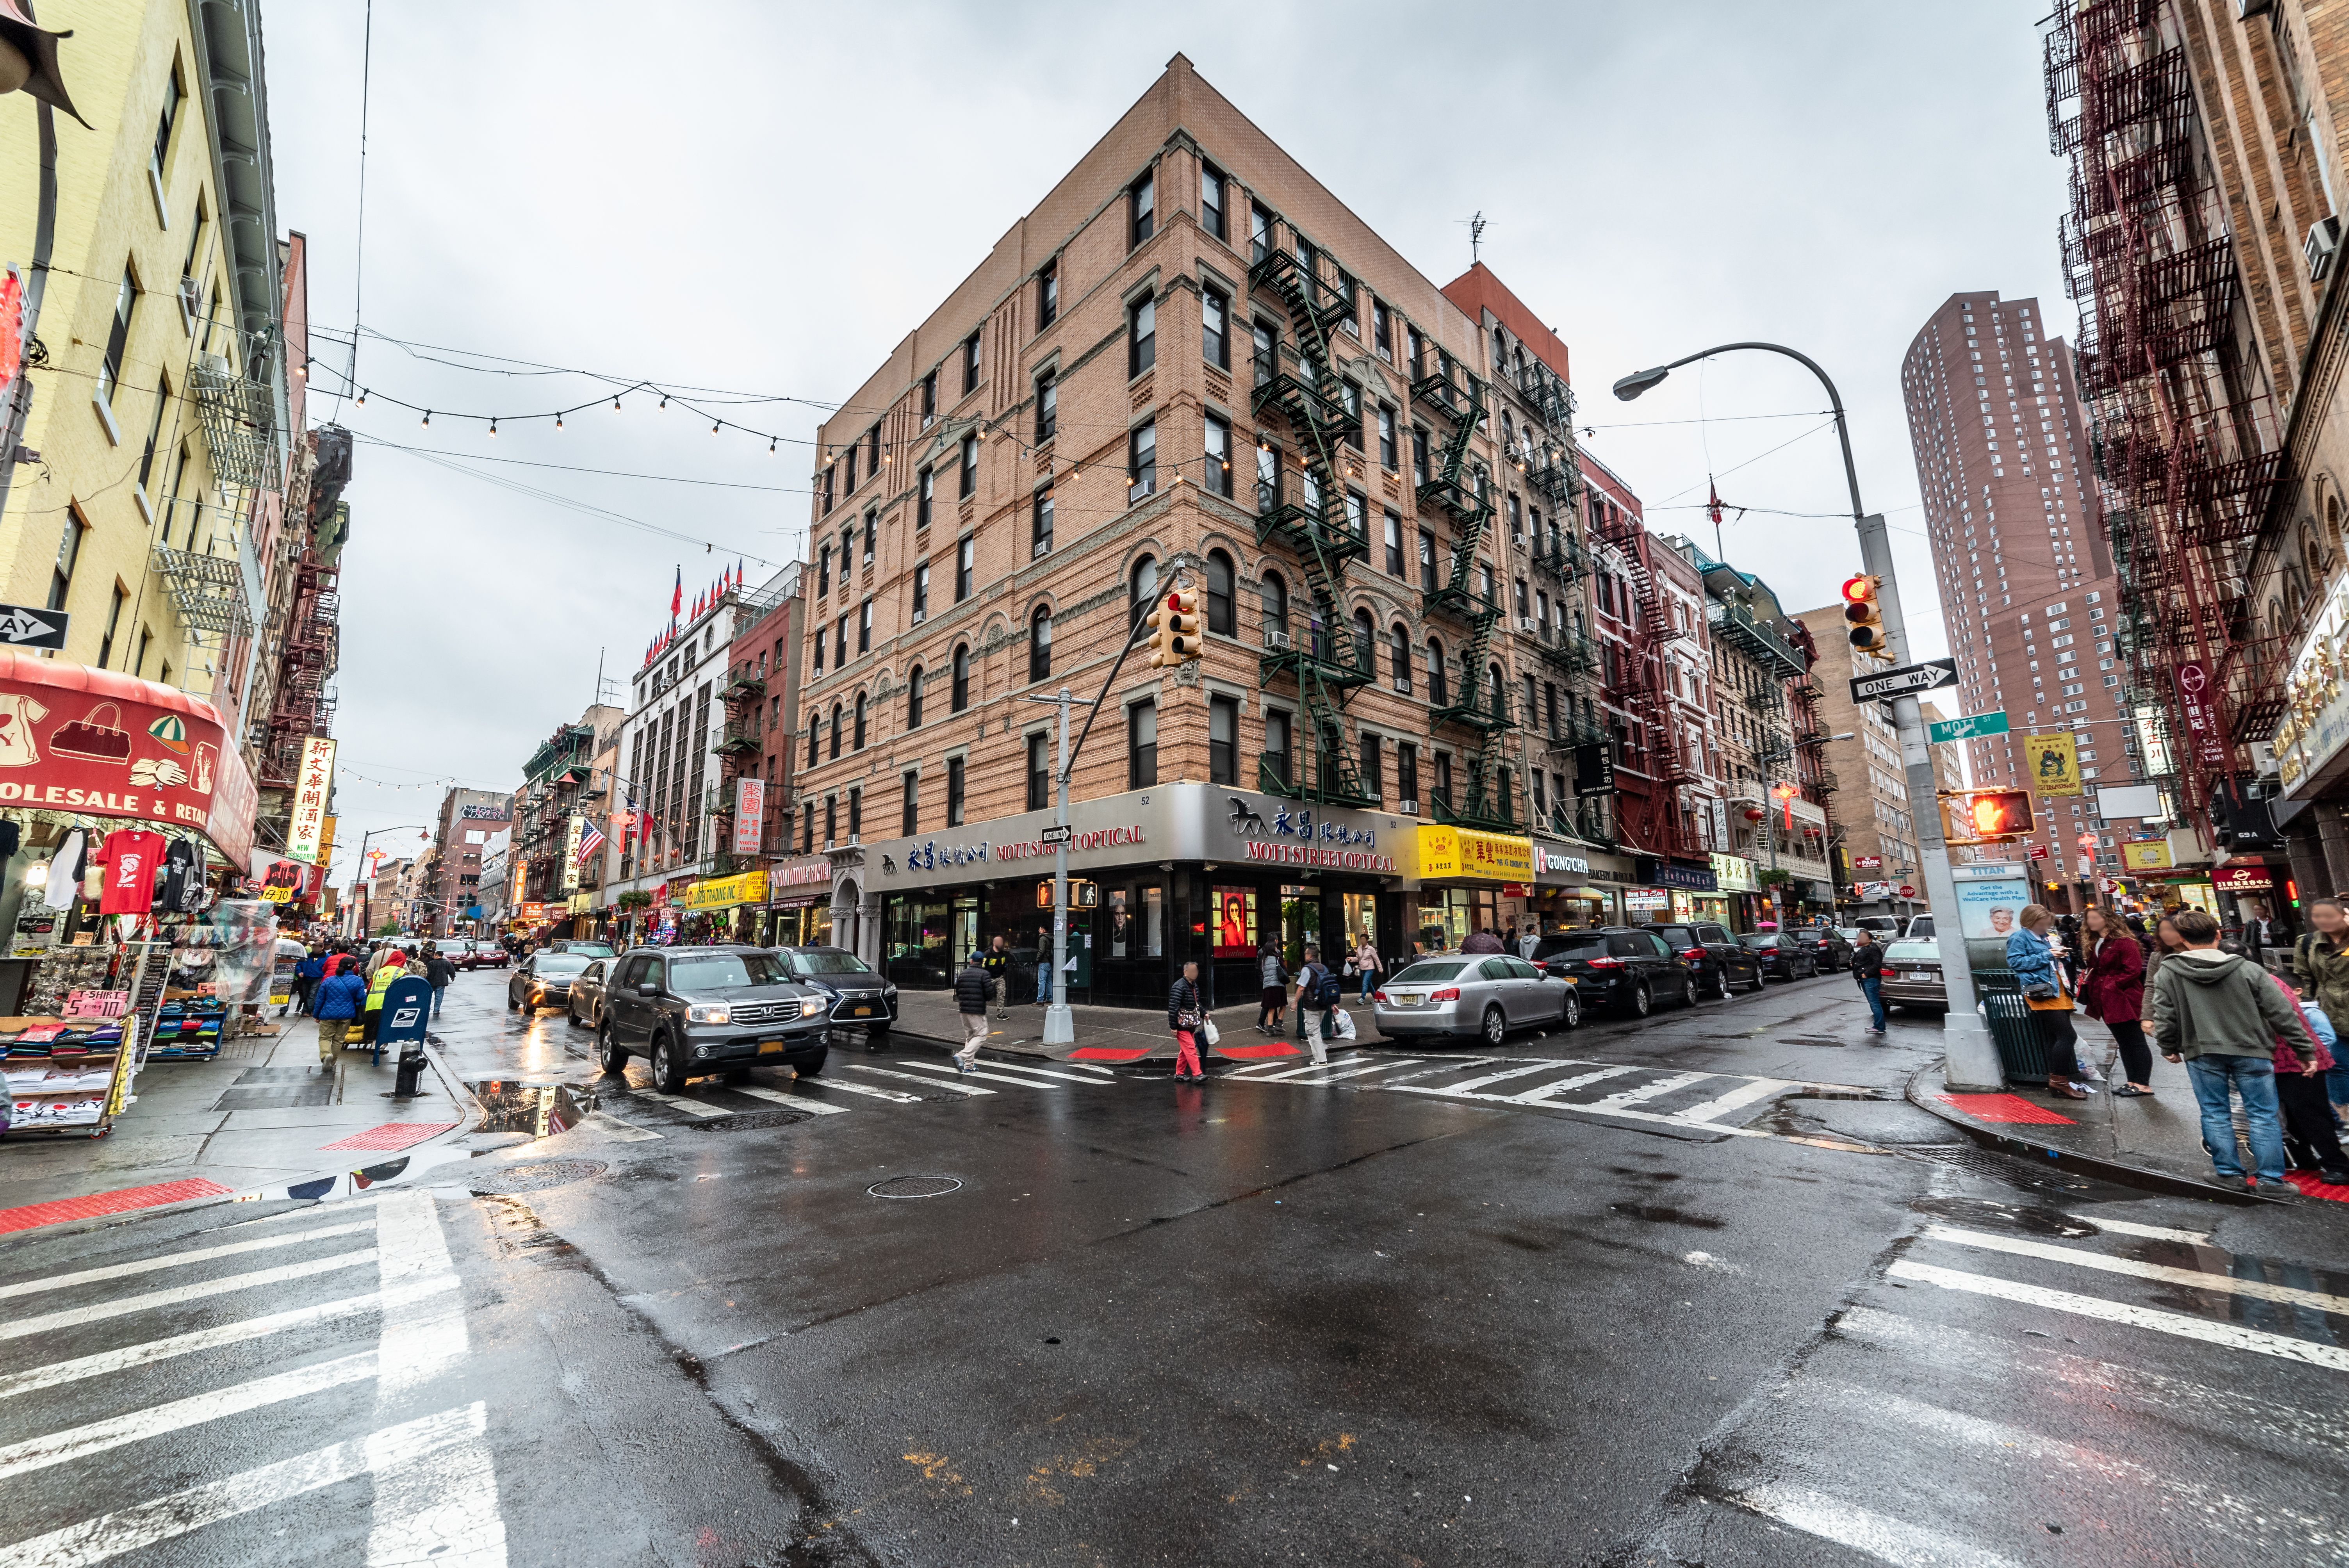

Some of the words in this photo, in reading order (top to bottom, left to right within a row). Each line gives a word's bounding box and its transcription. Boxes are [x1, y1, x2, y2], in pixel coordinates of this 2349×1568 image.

[1865, 679, 1895, 693] ONE
[1908, 669, 1939, 685] WAY
[1941, 718, 1976, 734] MOTT
[1141, 796, 1150, 805] 52
[153, 800, 166, 816] &
[176, 803, 207, 826] RETAIL
[1274, 805, 1375, 849] 永昌眼鏡公司
[996, 841, 1030, 861] MOTT
[1081, 825, 1145, 849] OPTICAL
[907, 840, 988, 871] 永昌眼鏡公司
[1246, 841, 1290, 862] MOTT
[1292, 846, 1343, 867] STREET
[1344, 852, 1397, 871] OPTICAL
[1547, 854, 1570, 871] GONG
[1572, 857, 1588, 873] CHA
[1588, 868, 1611, 880] BAKERY
[1970, 866, 2006, 875] TITAN
[707, 886, 726, 903] TRADING
[727, 885, 736, 900] INC.
[1226, 949, 1246, 957] Cartier
[78, 991, 121, 1000] T-SHIRT
[68, 1000, 82, 1015] 5
